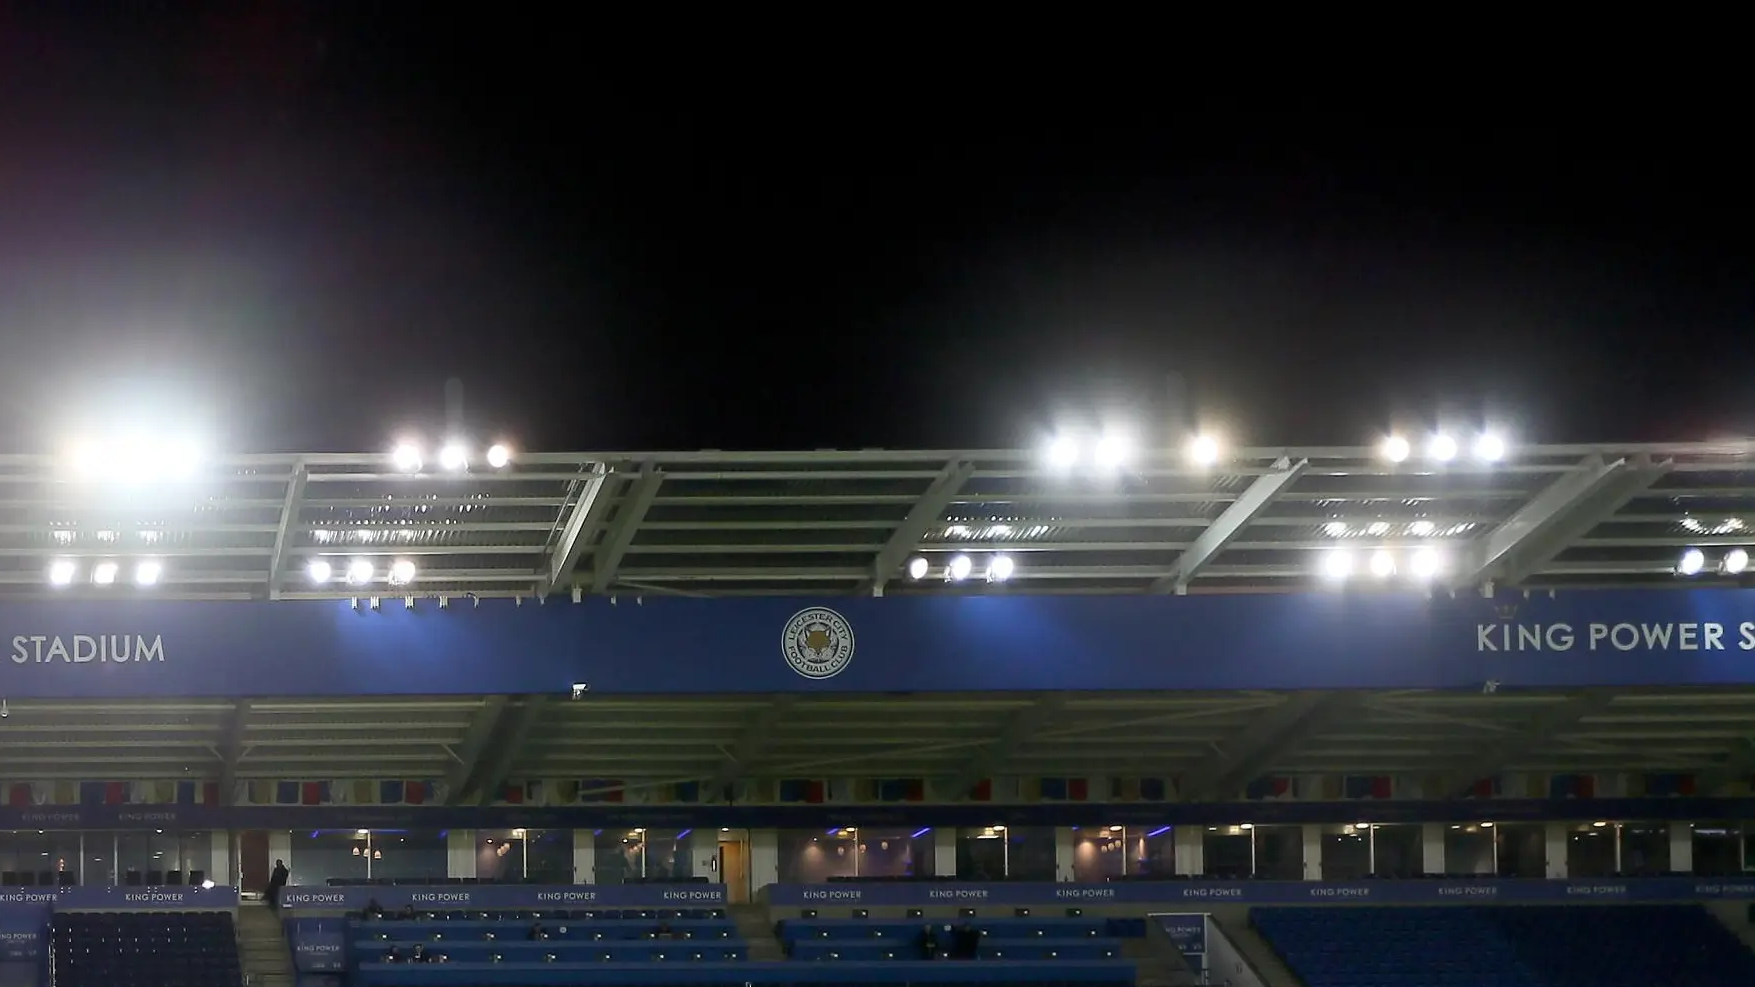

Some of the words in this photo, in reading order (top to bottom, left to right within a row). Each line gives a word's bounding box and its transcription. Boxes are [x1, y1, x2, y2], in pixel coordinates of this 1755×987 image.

[788, 613, 833, 640] LEICESTER
[833, 620, 848, 640] CITY
[1477, 624, 1575, 651] KING
[1589, 623, 1725, 651] POWER
[11, 634, 165, 663] STADIUM
[788, 645, 831, 673] FOOTBALL
[830, 645, 848, 668] CLUB
[537, 892, 561, 900] KING
[563, 892, 596, 900] POWER
[663, 891, 686, 900] KING
[689, 891, 722, 900] POWER
[803, 890, 826, 899] KING
[829, 890, 861, 899] POWER
[929, 890, 953, 898] KING
[955, 890, 988, 898] POWER
[1056, 889, 1079, 898] KING
[1082, 889, 1115, 898] POWER
[1183, 888, 1207, 897] KING
[1209, 888, 1242, 897] POWER
[1310, 888, 1334, 896] KING
[1336, 888, 1369, 896] POWER
[0, 893, 23, 903] KING
[25, 893, 58, 903] POWER
[125, 893, 148, 901] KING
[151, 893, 184, 901] POWER
[286, 894, 309, 902] KING
[312, 894, 345, 902] POWER
[412, 893, 435, 901] KING
[438, 893, 470, 901] POWER
